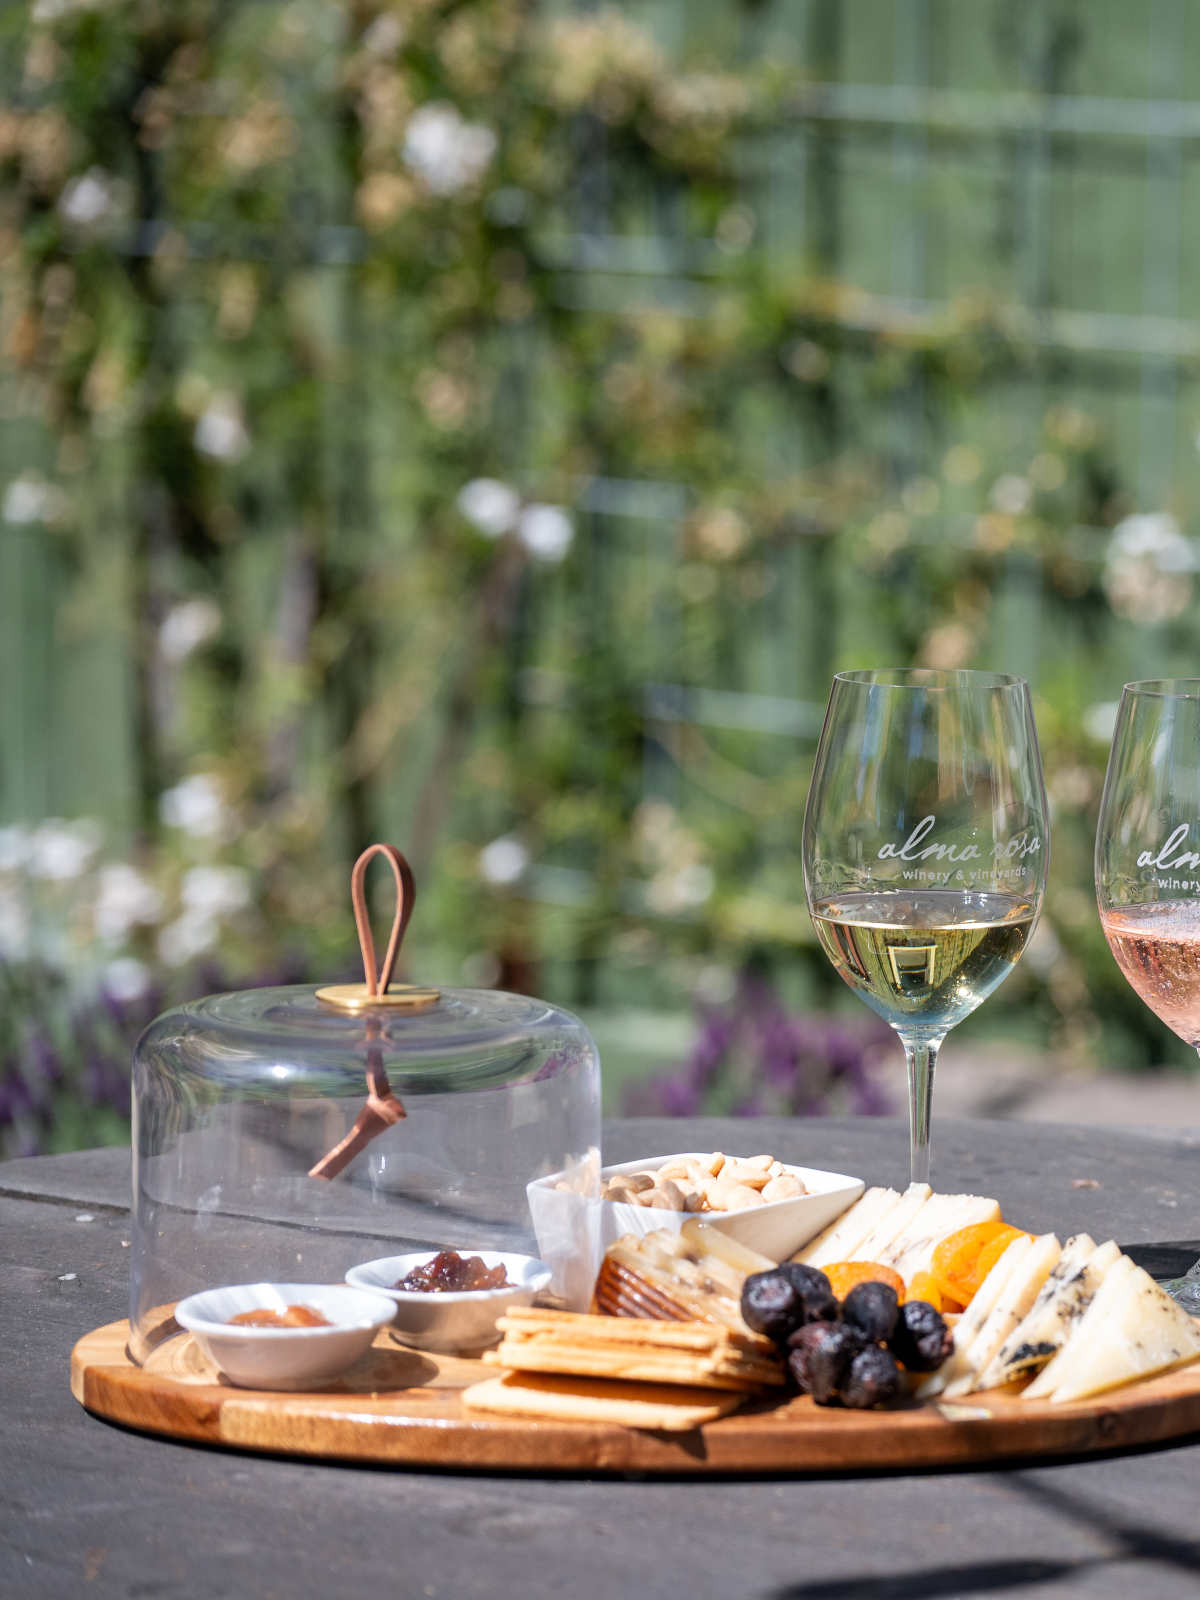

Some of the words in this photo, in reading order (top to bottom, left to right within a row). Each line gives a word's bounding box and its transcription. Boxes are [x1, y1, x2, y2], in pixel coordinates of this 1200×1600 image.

[877, 815, 981, 862] alma
[989, 833, 1041, 860] rosa
[903, 869, 949, 883] winery
[955, 869, 964, 880] &
[970, 866, 1026, 881] vineyards
